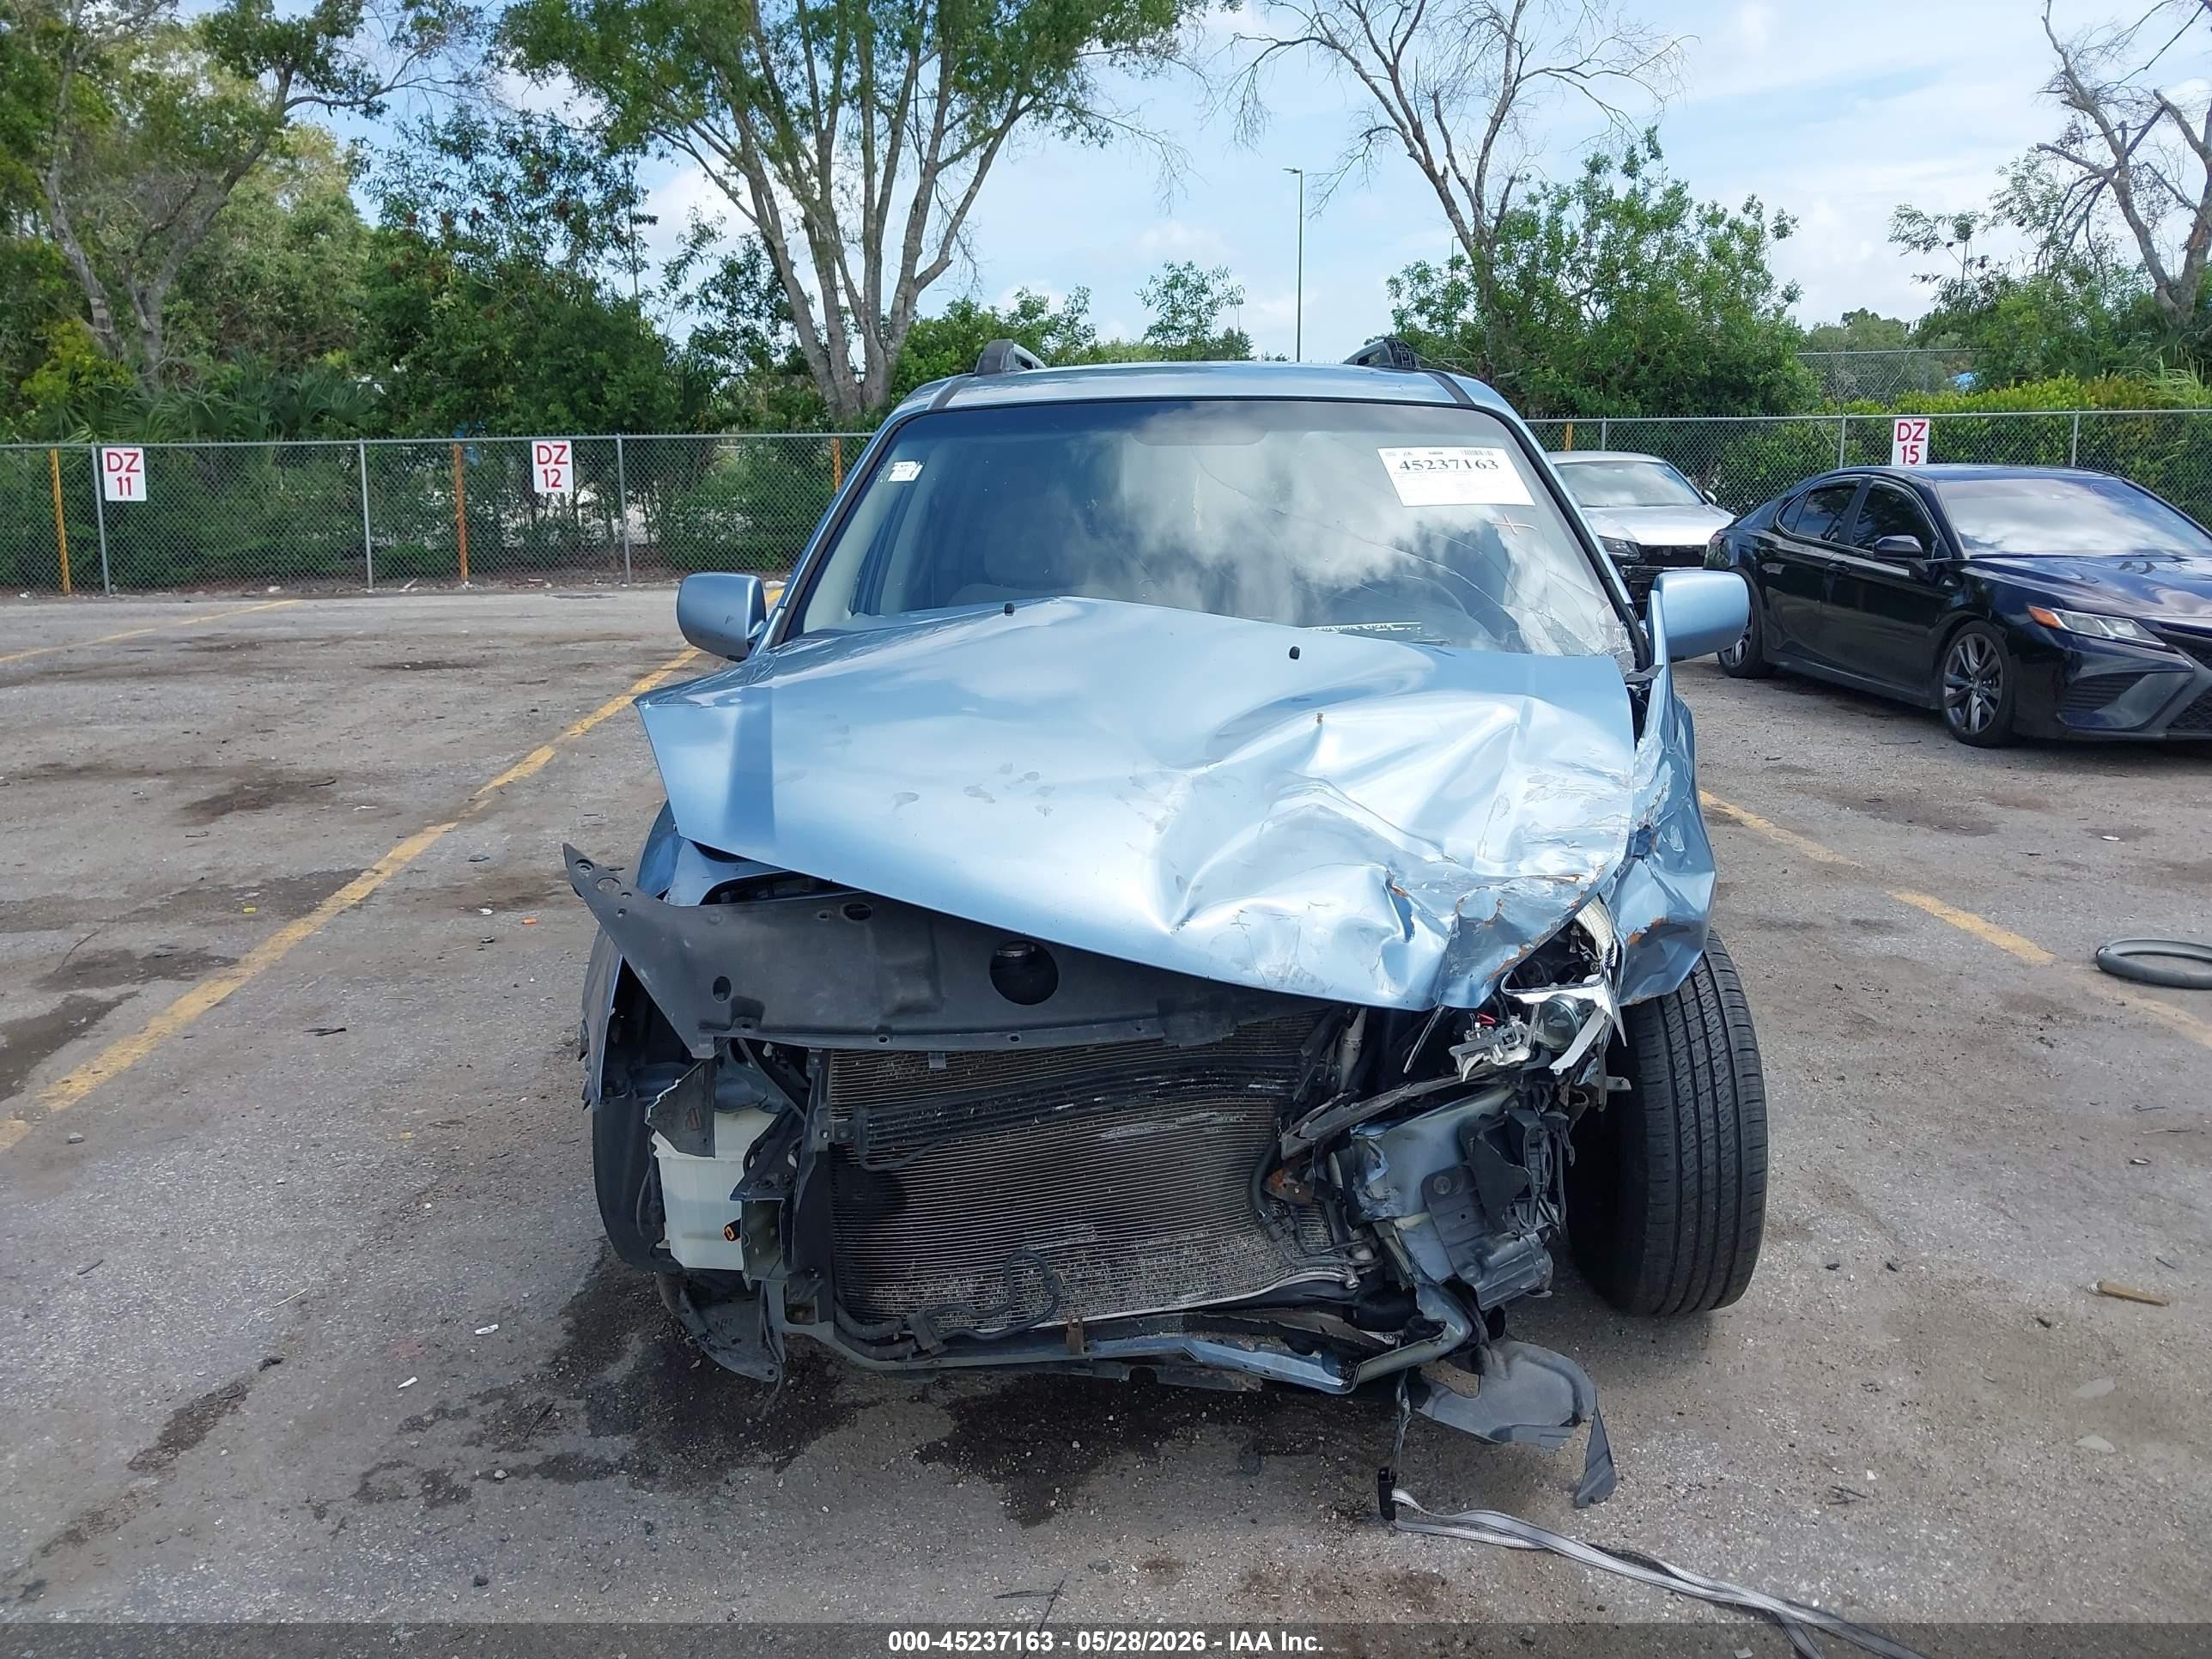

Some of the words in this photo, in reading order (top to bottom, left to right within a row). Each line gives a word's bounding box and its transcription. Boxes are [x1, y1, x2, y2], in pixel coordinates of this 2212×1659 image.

[1897, 422, 1927, 442] DZ
[106, 452, 141, 472] DZ
[536, 445, 568, 465] DZ
[1399, 459, 1499, 471] 45237163
[1901, 445, 1920, 465] 15
[117, 476, 132, 496] 11
[542, 468, 562, 488] 12
